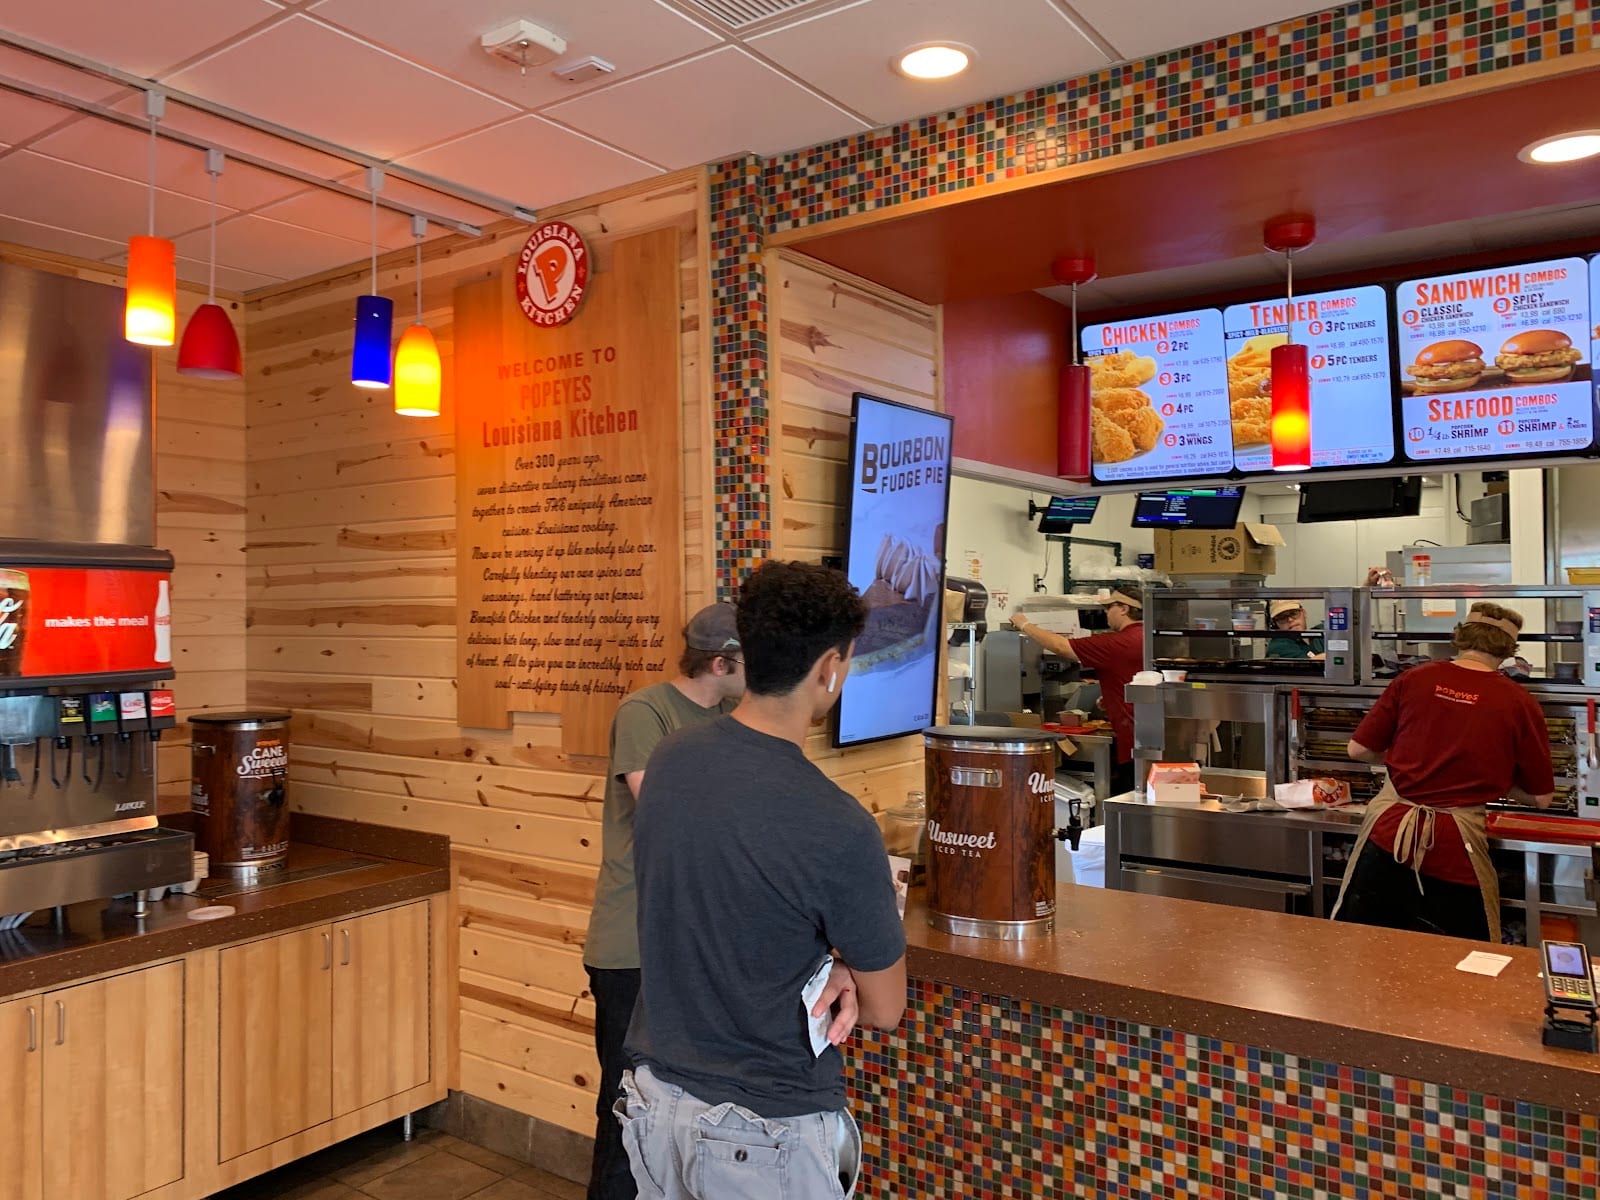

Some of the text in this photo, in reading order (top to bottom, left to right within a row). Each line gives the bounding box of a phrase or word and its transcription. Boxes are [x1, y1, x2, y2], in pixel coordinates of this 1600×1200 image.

[518, 223, 585, 276] LOUISIANA
[1416, 268, 1567, 307] SANDWICH COMBOS
[520, 283, 584, 326] KITCHEN
[1513, 292, 1545, 305] SPICY
[1540, 299, 1569, 308] SANDWICH
[1249, 300, 1318, 327] TENDER
[1321, 297, 1357, 311] COMBOS
[1421, 303, 1463, 317] CLASSIC
[1421, 311, 1474, 323] CHICKEN SANDWICH
[1102, 321, 1168, 346] CHICKEN
[1168, 318, 1200, 331] COMBOS
[1347, 320, 1376, 330] TENDERS
[498, 346, 616, 379] WELCOME TO
[1349, 354, 1378, 364] TENDERS
[520, 374, 592, 410] POPEYES
[1428, 396, 1514, 422] SEAFOOD
[1516, 393, 1557, 407] COMBOS
[483, 405, 638, 448] Louisiana Kitchen
[1451, 427, 1489, 439] SHRIMP
[1518, 422, 1557, 432] SHRIMP
[1186, 436, 1213, 446] WINGS
[536, 453, 555, 468] 300
[557, 456, 581, 472] years
[862, 436, 944, 485] BOURBON
[499, 481, 539, 493] distinctive
[543, 475, 576, 493] culinary
[579, 472, 622, 487] traditions
[625, 473, 646, 483] came
[881, 466, 943, 494] FUDGE PIE
[472, 503, 505, 522] together
[507, 504, 515, 514] to
[517, 502, 541, 514] create
[567, 494, 605, 514] uniquely
[609, 493, 652, 507] American
[535, 521, 579, 534] Louisiana
[472, 546, 489, 560] Now
[515, 547, 544, 562] serving
[546, 546, 554, 556] it
[555, 549, 565, 560] up
[567, 541, 583, 555] like
[585, 541, 616, 560] nobody
[618, 539, 635, 554] else
[483, 563, 644, 585] Carefully blending our own spices and
[530, 588, 553, 601] hand
[554, 588, 592, 606] battering
[594, 592, 609, 600] our
[611, 587, 644, 603] famous
[45, 615, 149, 627] makes the meal
[509, 610, 541, 623] Chicken
[543, 610, 561, 623] and
[561, 609, 596, 629] tenderly
[599, 609, 633, 630] cooking
[636, 615, 660, 630] every
[467, 631, 501, 645] delicious
[503, 632, 517, 645] bite
[544, 632, 562, 646] slow
[564, 633, 582, 646] and
[583, 638, 602, 652] easy
[618, 633, 639, 647] with
[641, 639, 647, 647] a
[650, 633, 664, 647] lot
[466, 653, 476, 668] of
[503, 654, 519, 667] All
[518, 656, 527, 667] to
[528, 657, 545, 673] give
[546, 660, 563, 674] you
[565, 660, 576, 669] an
[578, 655, 622, 677] incredibly
[625, 657, 644, 671] rich
[646, 658, 666, 672] and
[560, 680, 581, 692] taste
[582, 679, 592, 695] of
[593, 679, 633, 700] history!
[252, 745, 284, 759] CANE
[928, 819, 997, 850] Unsweet
[935, 846, 981, 858] ICED TEA
